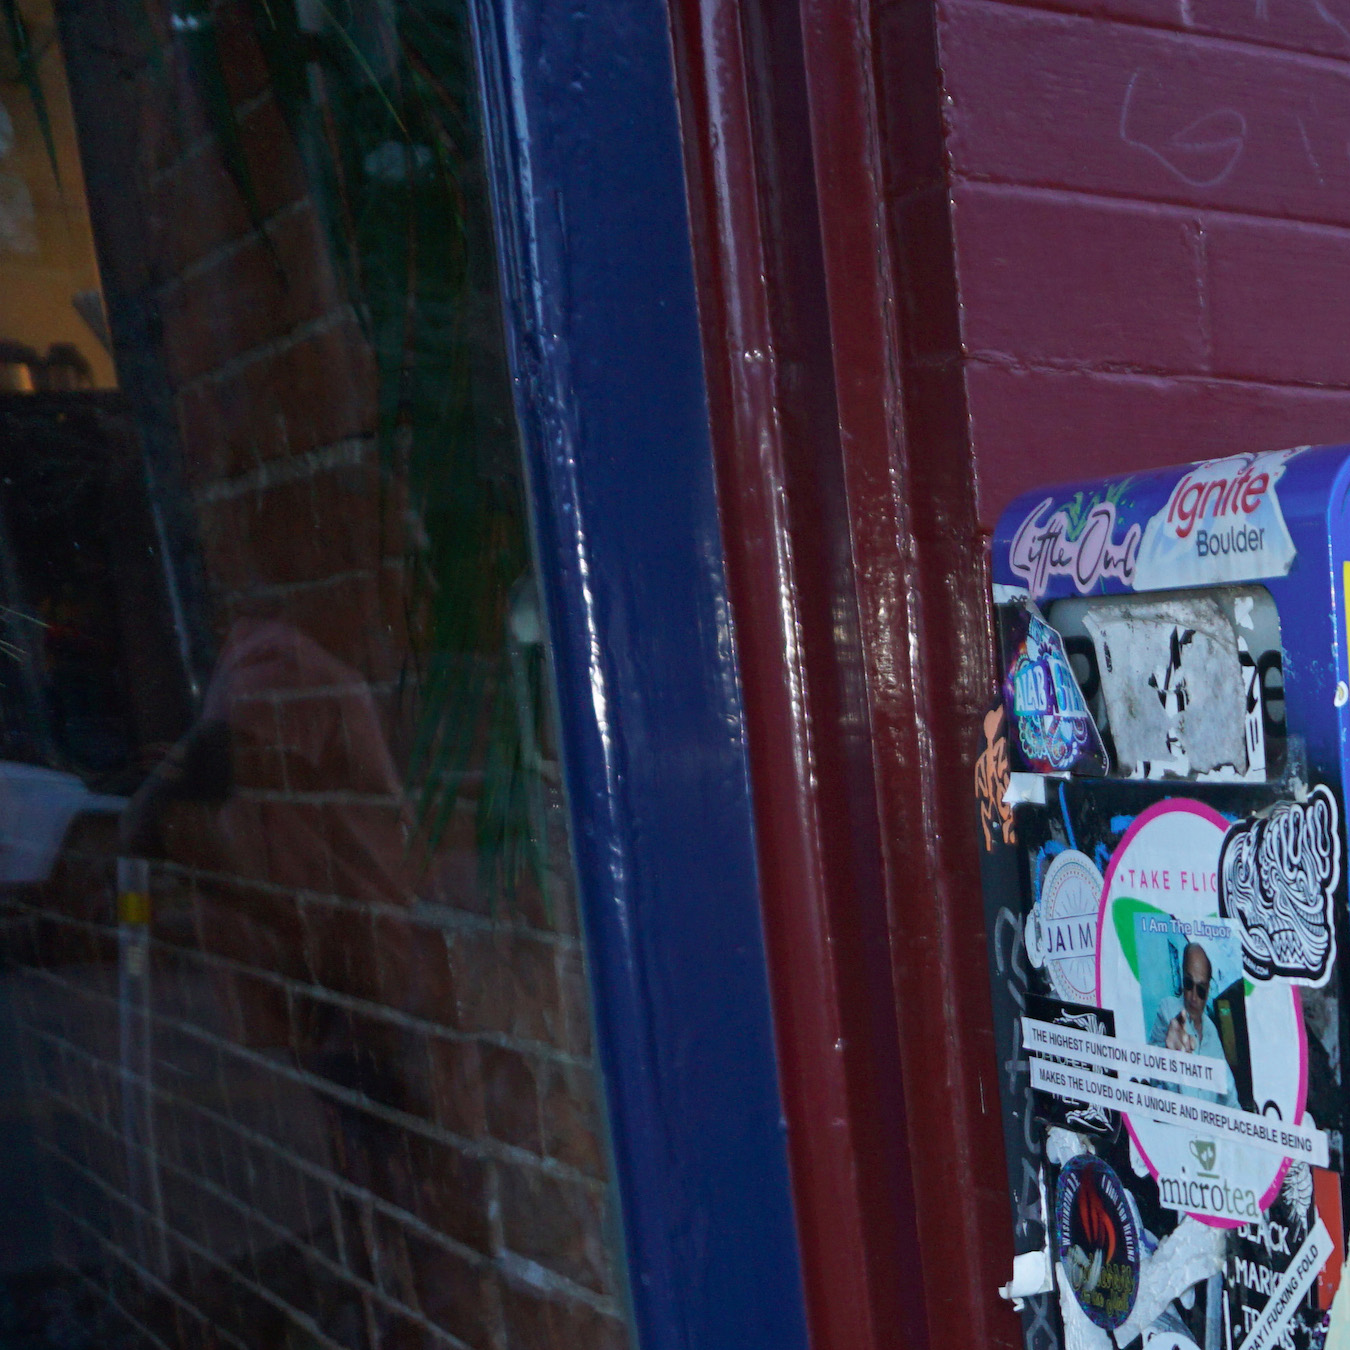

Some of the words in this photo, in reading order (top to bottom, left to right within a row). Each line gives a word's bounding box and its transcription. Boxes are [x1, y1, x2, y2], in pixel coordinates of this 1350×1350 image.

[1166, 466, 1271, 539] Ignite
[1196, 523, 1266, 558] Boulder
[1127, 868, 1171, 891] TAKE
[1046, 920, 1099, 954] JAIM
[1141, 917, 1147, 932] I
[1149, 918, 1169, 934] Am
[1170, 918, 1192, 936] The
[1193, 919, 1232, 941] Liquor
[1031, 1028, 1048, 1043] THE
[1049, 1032, 1084, 1052] HIGHEST
[1086, 1041, 1128, 1062] FUNCTION
[1129, 1052, 1142, 1065] OF
[1143, 1054, 1167, 1071] LOVE
[1169, 1060, 1178, 1073] IS
[1179, 1061, 1203, 1079] THAT
[1205, 1067, 1214, 1081] IT
[1039, 1068, 1067, 1087] MAKES
[1068, 1075, 1084, 1091] THE
[1086, 1082, 1114, 1099] LOVED
[1115, 1089, 1134, 1105] ONE
[1136, 1092, 1143, 1107] A
[1144, 1094, 1178, 1115] UNIQUE
[1179, 1104, 1199, 1121] AND
[1200, 1109, 1279, 1144] IRREPLACEABLE
[1281, 1132, 1313, 1153] BEING
[1160, 1166, 1260, 1219] microtea
[1266, 1278, 1299, 1329] FUCKING
[1298, 1243, 1320, 1281] FOLD
